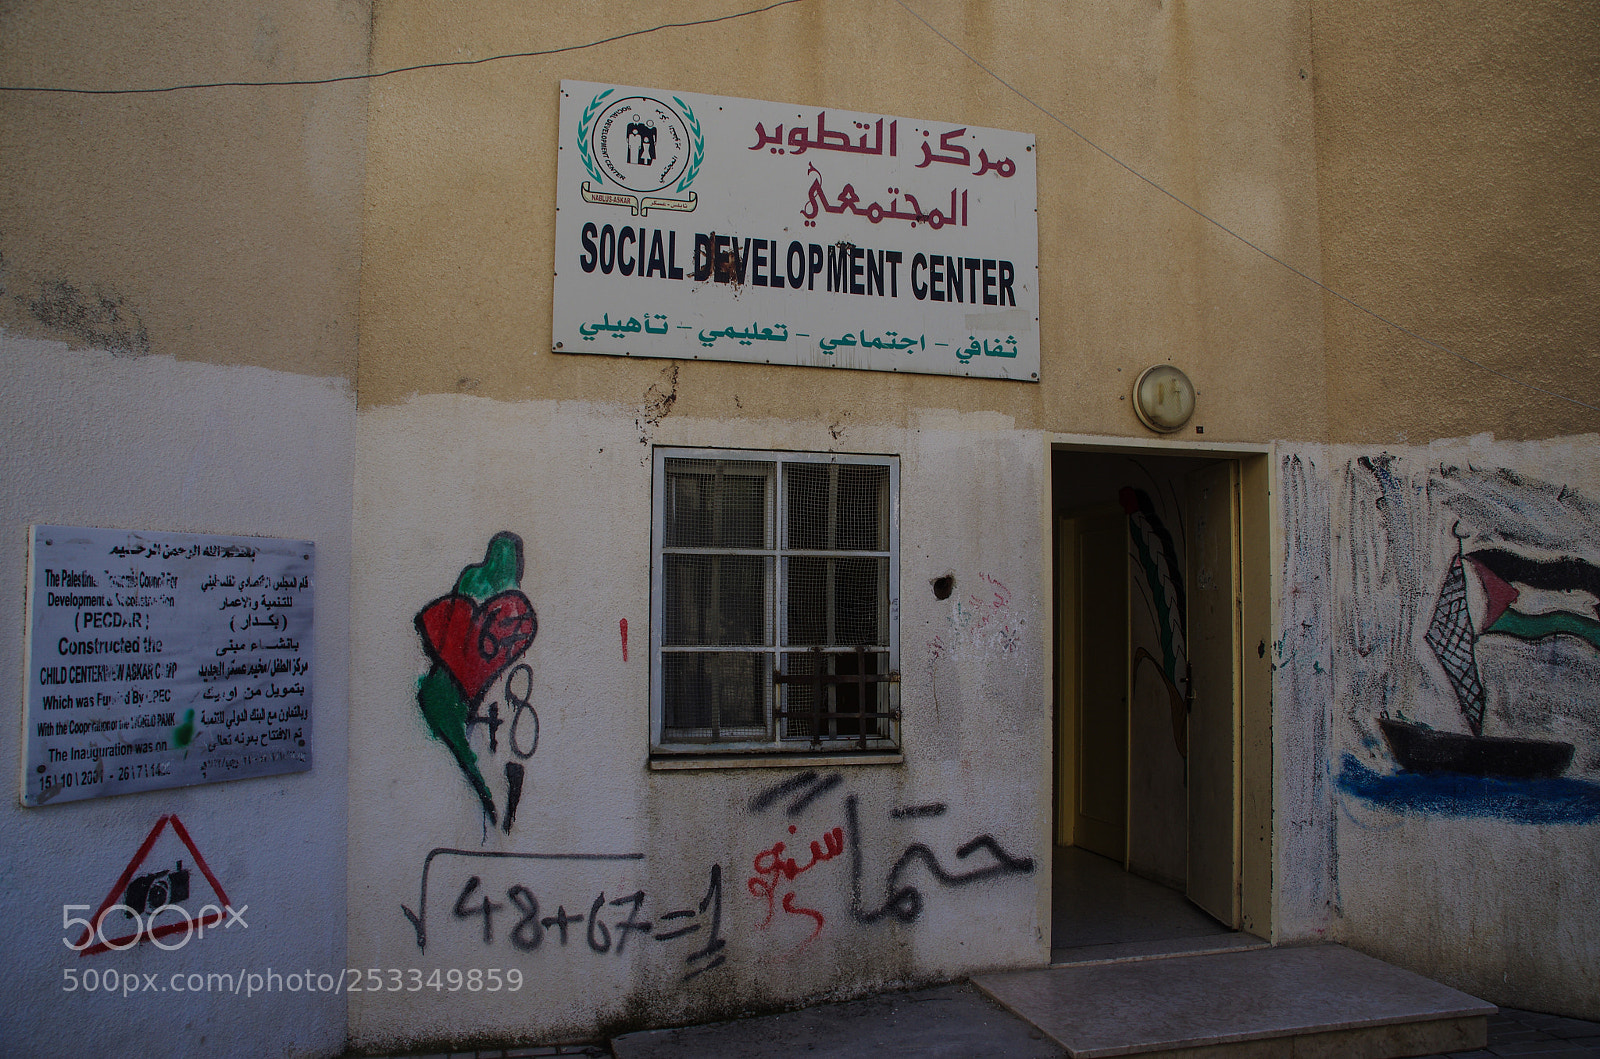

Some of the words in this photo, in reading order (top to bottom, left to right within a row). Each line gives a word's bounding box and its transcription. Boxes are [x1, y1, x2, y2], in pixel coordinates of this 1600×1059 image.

[600, 118, 614, 159] DEVELOPMENT
[748, 111, 898, 157] التطوير
[914, 127, 1016, 179] مركز
[604, 159, 627, 181] CENTER
[800, 161, 968, 230] المجتمعي
[579, 221, 684, 280] SOCIAL
[694, 231, 902, 299] DEVELOPMENT
[911, 252, 1017, 308] CENTER
[579, 312, 669, 341] تأهيلي
[698, 321, 788, 346] تعليمي
[820, 330, 925, 356] اجتماعي
[956, 334, 1018, 365] ثقافي
[45, 568, 60, 588] The
[61, 569, 99, 589] Palestin
[47, 592, 105, 610] Development
[58, 636, 140, 655] Constructed
[40, 666, 67, 686] CHILD
[42, 694, 73, 711] Which
[75, 696, 94, 709] was
[244, 687, 261, 700] من
[37, 721, 54, 738] With
[56, 722, 68, 736] the
[48, 747, 68, 764] The
[70, 743, 133, 763] Inauguration
[135, 742, 153, 755] was
[155, 740, 168, 753] on
